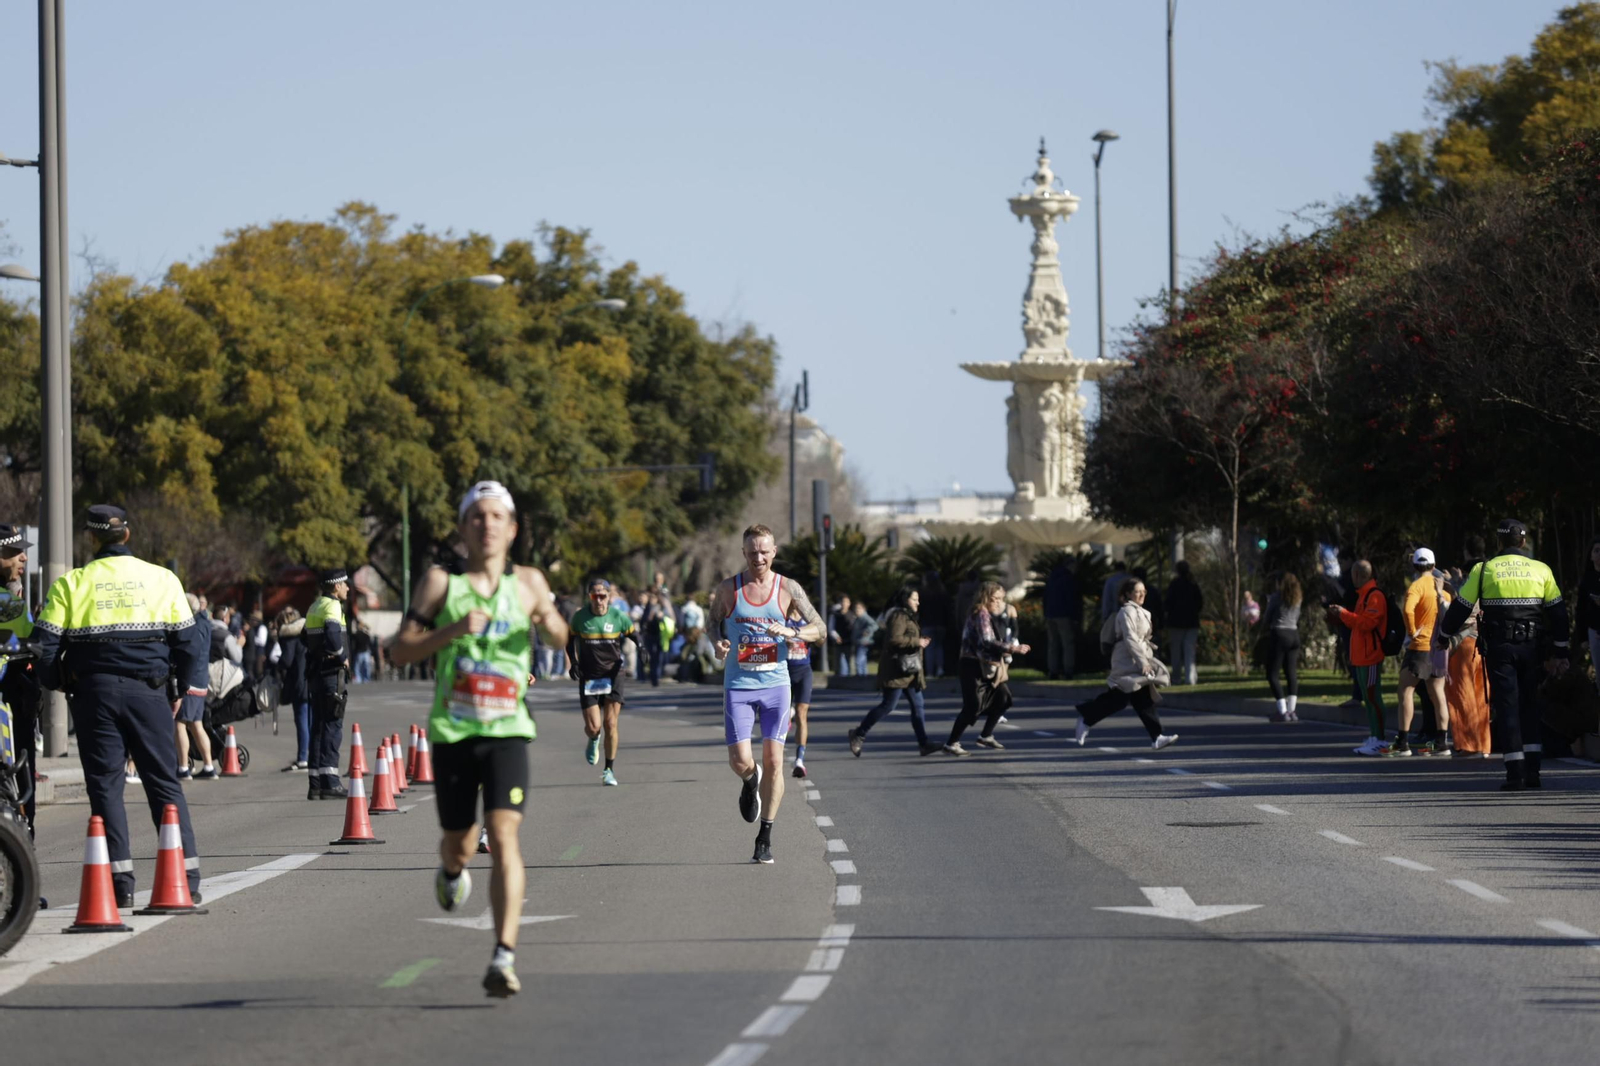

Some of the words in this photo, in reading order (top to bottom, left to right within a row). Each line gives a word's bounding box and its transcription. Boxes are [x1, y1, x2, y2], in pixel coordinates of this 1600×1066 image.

[95, 581, 145, 592] POLICIA
[96, 598, 147, 610] SEVILLA
[748, 654, 768, 662] JOSH
